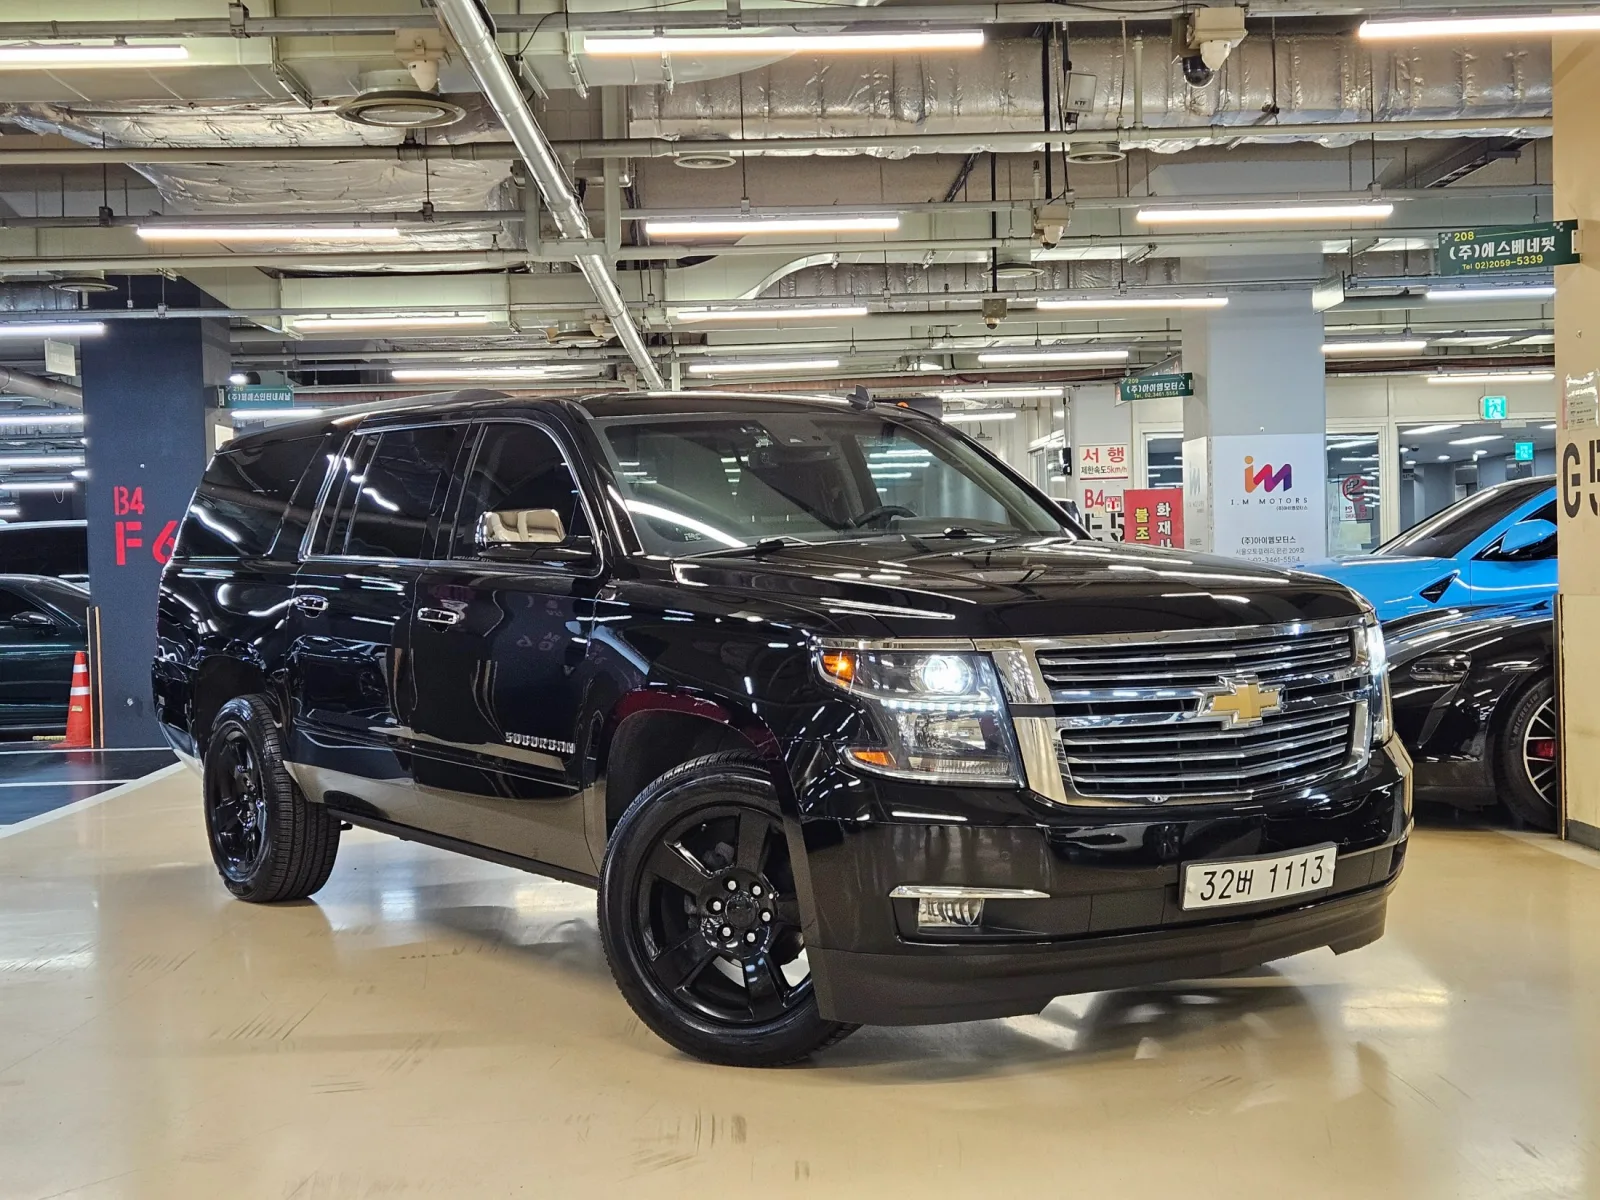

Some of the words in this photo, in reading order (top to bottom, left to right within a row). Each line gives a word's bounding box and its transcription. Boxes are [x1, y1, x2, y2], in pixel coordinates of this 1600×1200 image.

[1454, 231, 1475, 242] 208
[1449, 235, 1556, 261] (주)에스베네핏
[1474, 254, 1544, 270] 02)2059-5339
[1126, 381, 1186, 394] (주)아이엠모터스
[113, 485, 145, 516] B4
[1084, 488, 1105, 509] B4
[1258, 497, 1308, 505] MOTORS
[1241, 536, 1297, 545] (주)아이엠모터스
[1512, 693, 1539, 735] MICHELIN
[505, 731, 576, 754] SUBURBAN
[1199, 868, 1254, 901] 32버
[1269, 855, 1326, 893] 1113
